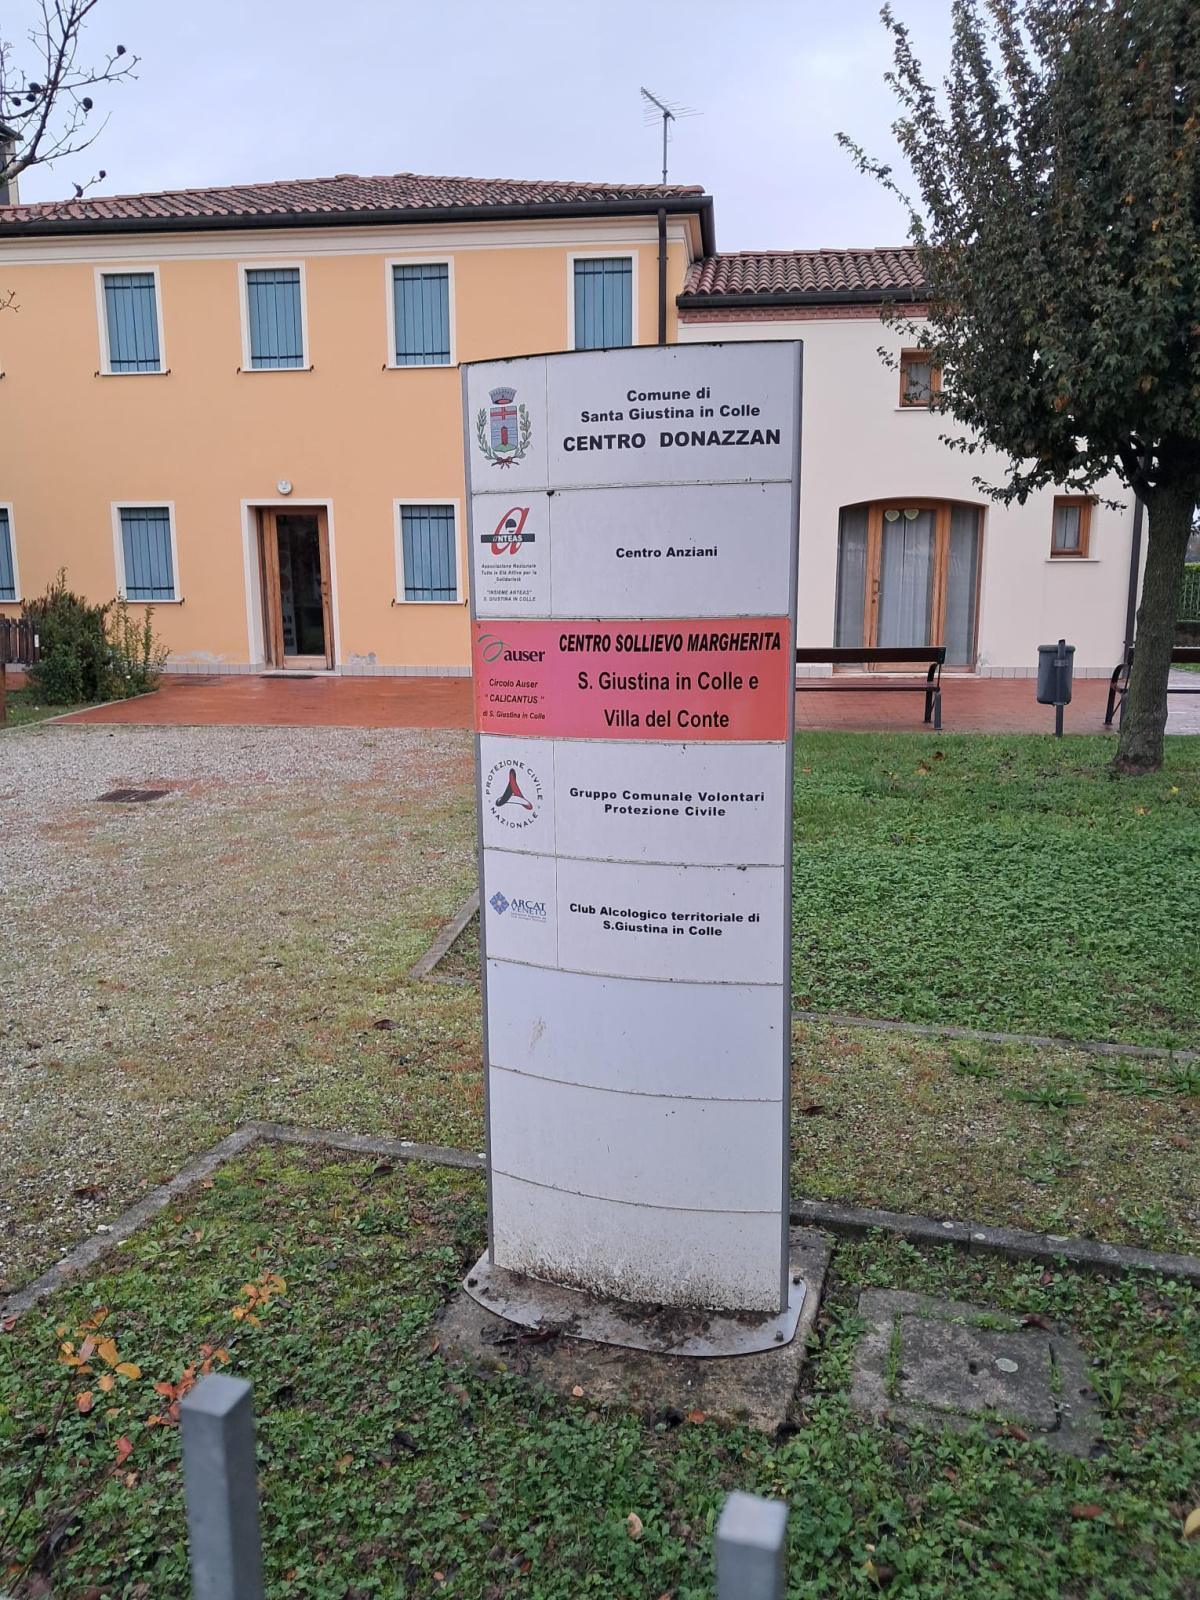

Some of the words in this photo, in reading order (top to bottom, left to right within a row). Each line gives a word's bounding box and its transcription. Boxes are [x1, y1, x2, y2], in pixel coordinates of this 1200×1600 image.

[626, 389, 691, 402] Comune
[696, 387, 711, 399] di
[580, 410, 624, 423] Santa
[628, 407, 695, 421] Giustina
[700, 405, 714, 418] in
[719, 404, 761, 417] Colle
[563, 432, 646, 452] CENTRO
[660, 429, 781, 448] DONAZZAN
[615, 547, 662, 558] Centro
[666, 546, 718, 557] Anziani
[559, 633, 611, 652] CENTRO
[615, 633, 684, 652] SOLLIEVO
[687, 632, 781, 652] MARGHERITA
[503, 649, 546, 662] auser
[489, 678, 514, 688] Circolo
[515, 679, 538, 689] Auser
[577, 671, 593, 690] S.
[598, 671, 670, 690] Giustina
[676, 671, 691, 690] in
[697, 671, 743, 690] Colle
[748, 675, 759, 690] e
[496, 710, 521, 719] Giustina
[529, 712, 546, 720] Colle
[604, 709, 640, 727] Villa
[645, 709, 671, 728] del
[677, 709, 730, 728] Conte
[486, 759, 525, 795] PROTEZIONE
[527, 768, 544, 801] CIVILE
[569, 787, 617, 801] Gruppo
[622, 790, 693, 801] Comunale
[698, 791, 765, 802] Volontari
[490, 806, 539, 829] NAZIONALE
[604, 803, 680, 816] Protezione
[685, 806, 726, 817] Civile
[511, 898, 546, 911] ARCAT
[511, 905, 547, 917] VENETO
[569, 903, 596, 915] Club
[599, 906, 667, 921] Alcologico
[671, 911, 744, 923] territoriale
[748, 912, 760, 923] di
[603, 920, 668, 935] S.Giustina
[672, 924, 684, 935] in
[688, 925, 723, 936] Colle
